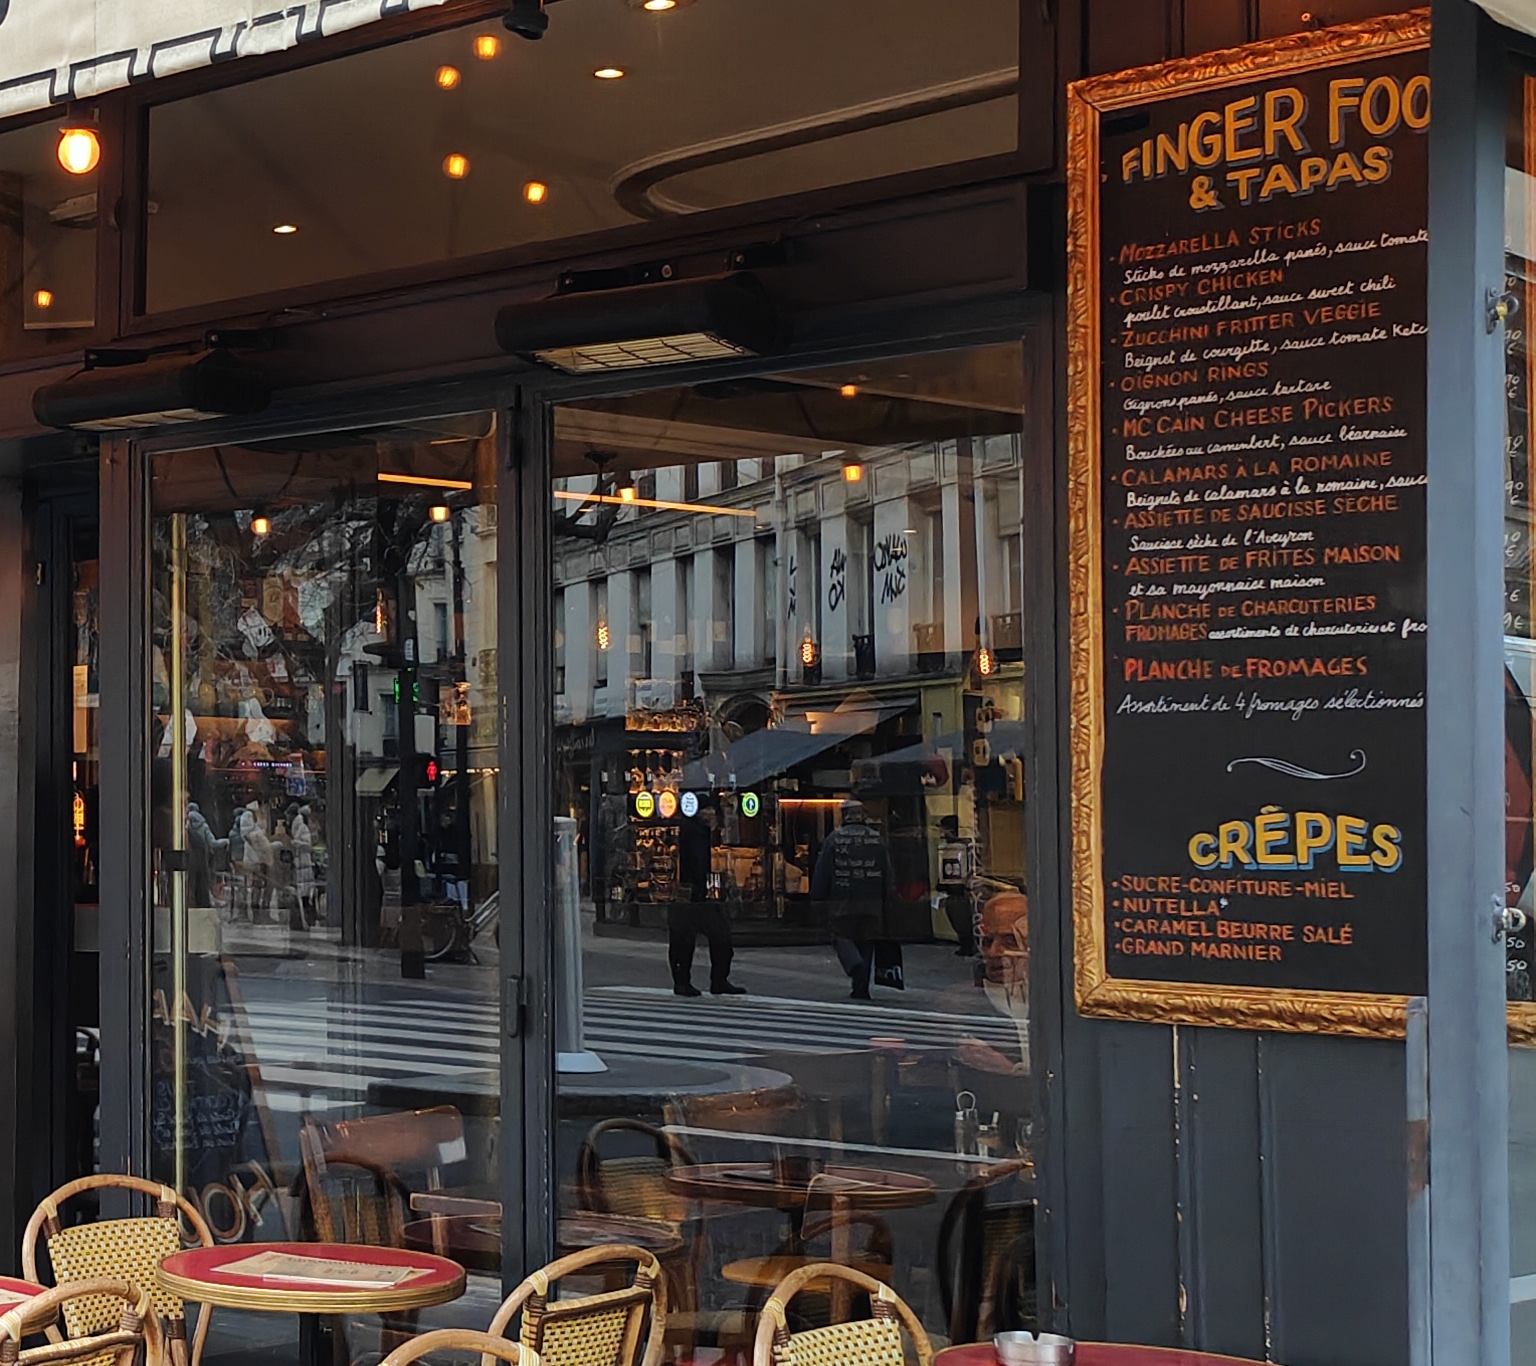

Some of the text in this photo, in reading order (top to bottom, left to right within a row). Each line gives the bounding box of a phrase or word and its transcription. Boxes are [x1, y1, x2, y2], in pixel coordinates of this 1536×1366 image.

[1122, 75, 1431, 185] FINGER FOO
[1188, 146, 1393, 212] & TAPAS
[1119, 219, 1321, 265] MOZZARELLA STICKS
[1124, 268, 1164, 284] Sticks
[1169, 262, 1186, 278] de
[1191, 250, 1280, 274] mozzarella
[1335, 238, 1376, 253] sauce
[1380, 229, 1429, 248] tomate
[1120, 268, 1284, 306] CRISPY CHICKEN
[1124, 304, 1170, 328] poulet
[1308, 282, 1354, 300] sweet
[1360, 273, 1396, 292] chili
[1122, 302, 1381, 348] ZUCCHINI FRITTER VEGGIE
[1124, 349, 1175, 372] Beignet
[1180, 344, 1197, 363] de
[1280, 337, 1325, 351] sauce
[1328, 327, 1388, 346] tomate
[1392, 322, 1429, 337] Ketc
[1121, 361, 1270, 393] OIGNON RINGS
[1214, 405, 1293, 428] CHEESE
[1303, 396, 1394, 420] PICKERS
[1289, 434, 1333, 447] sauce
[1121, 464, 1228, 486] CALAMARS
[1254, 464, 1280, 476] LA
[1290, 451, 1393, 473] ROMAINE
[1126, 491, 1181, 510] Beignets
[1184, 488, 1200, 503] de
[1204, 483, 1277, 502] calamars
[1280, 479, 1292, 495] à
[1295, 476, 1311, 494] la
[1385, 473, 1429, 488] sauc
[1124, 507, 1205, 529] ASSIETTE
[1211, 507, 1231, 523] DE
[1238, 499, 1326, 522] SAUCISSE
[1221, 530, 1238, 546] de
[1124, 545, 1400, 576] ASSIETTE DE FRITES MAISON
[1270, 575, 1326, 589] maison
[1124, 596, 1376, 621] PLANCHE DE CHARCUTERIES
[1125, 624, 1207, 642] FROMAGES
[1124, 656, 1367, 683] PLANCHE DE FROMAGES
[1116, 688, 1425, 719] Assortiment de 4 fromages sélectionnés
[1188, 805, 1402, 873] CRÊPES
[1123, 897, 1220, 917] NUTELLA
[1122, 919, 1353, 945] CARAMEL BEURRE SALÉ
[1122, 938, 1282, 962] GRAND MARNIER
